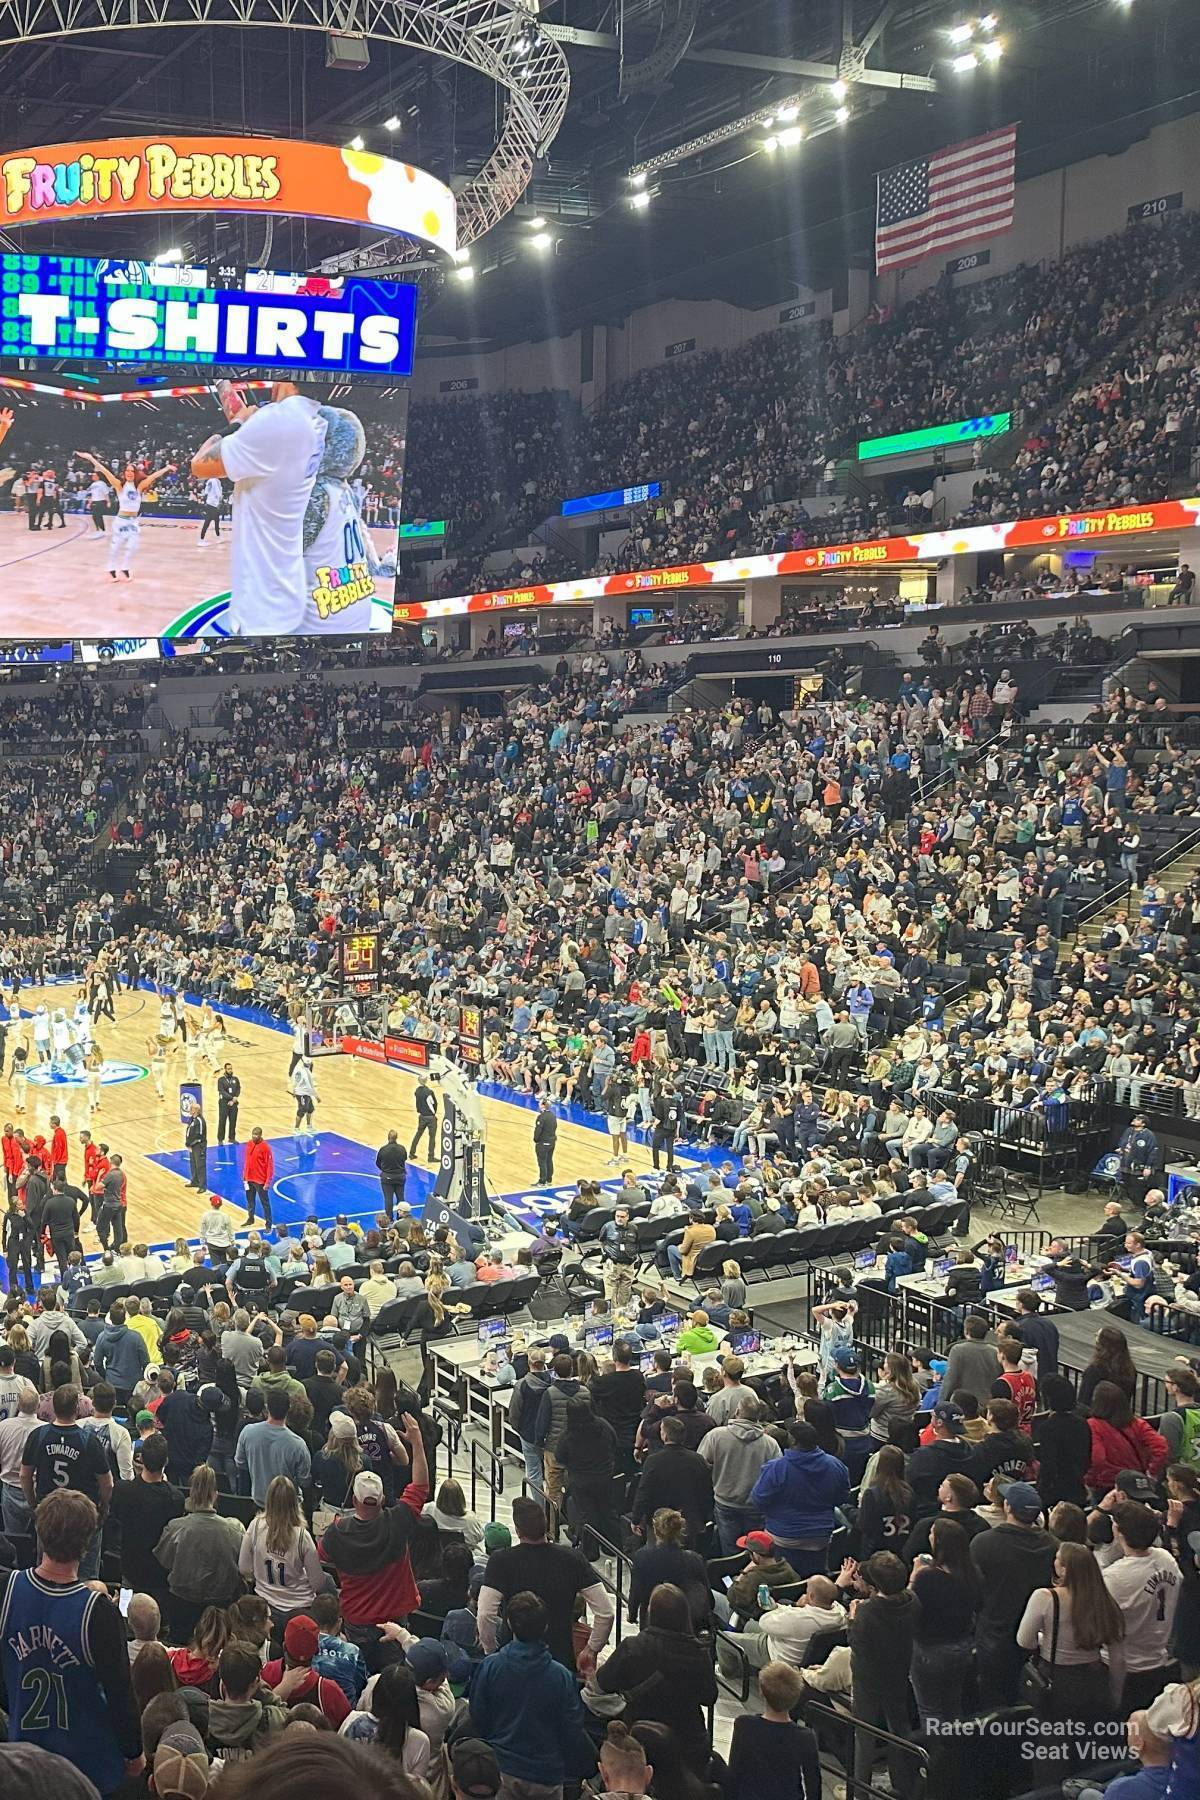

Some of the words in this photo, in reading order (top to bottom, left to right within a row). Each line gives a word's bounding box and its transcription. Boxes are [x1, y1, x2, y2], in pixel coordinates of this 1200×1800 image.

[146, 144, 281, 199] PEBBLES
[1142, 198, 1167, 217] 210
[218, 266, 236, 276] 3:35
[958, 256, 977, 271] 209
[2, 272, 40, 294] 89
[174, 263, 193, 286] 15
[257, 270, 275, 291] 21
[19, 294, 399, 364] T-SHIRTS
[672, 342, 688, 355] 207
[450, 379, 469, 391] 206
[1107, 512, 1154, 531] PEBBLES
[853, 546, 887, 562] PEBBLES
[312, 576, 376, 620] PEBBLES
[768, 654, 782, 664] 110
[352, 937, 375, 950] 3:35
[348, 951, 373, 971] 24
[353, 973, 378, 981] TISSOT
[46, 1444, 80, 1461] EDWARDS
[53, 1460, 70, 1487] 5
[882, 1515, 910, 1537] 32
[265, 1560, 285, 1586] 11
[1144, 1569, 1177, 1595] EDWARDS
[1156, 1587, 1165, 1621] 1
[8, 1625, 80, 1670] GARNETT
[20, 1667, 69, 1731] 21
